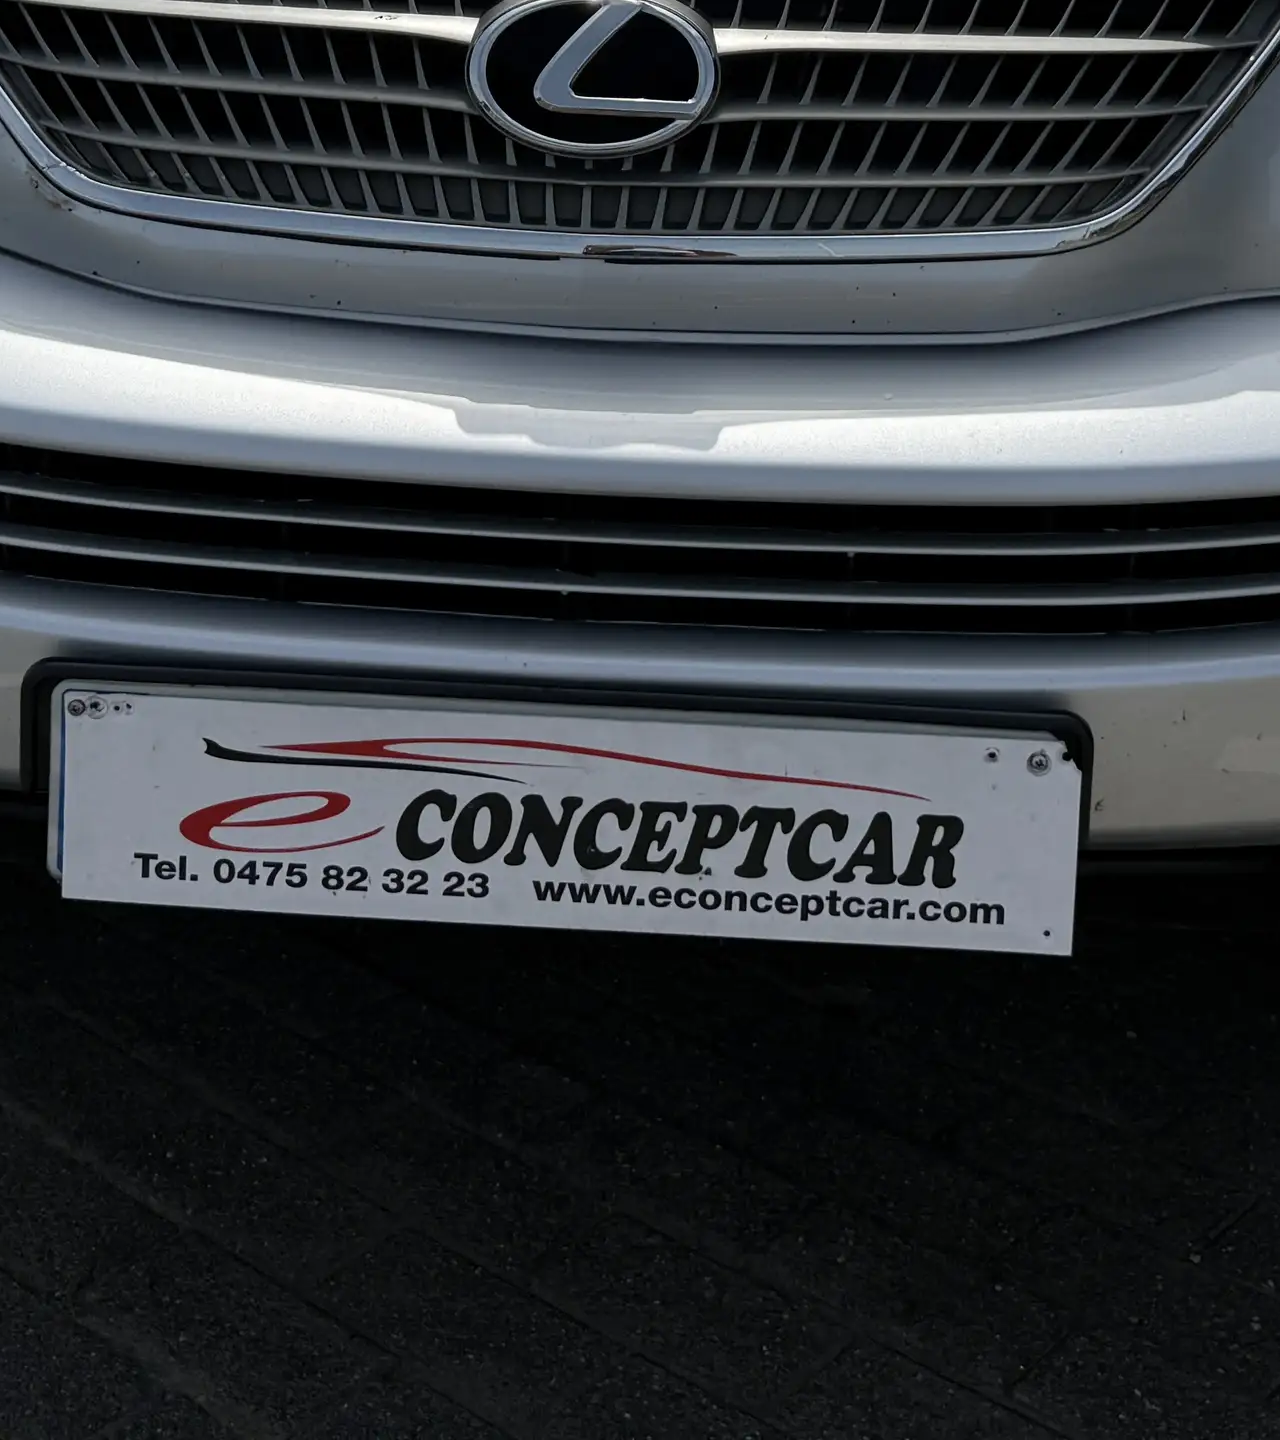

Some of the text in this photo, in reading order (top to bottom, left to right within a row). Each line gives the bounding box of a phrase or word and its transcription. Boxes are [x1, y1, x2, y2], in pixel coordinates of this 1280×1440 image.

[396, 789, 964, 888] CONCEPTCAR
[134, 853, 1006, 925] Tel. 0475 82 32 23 www.econceptcar.com
